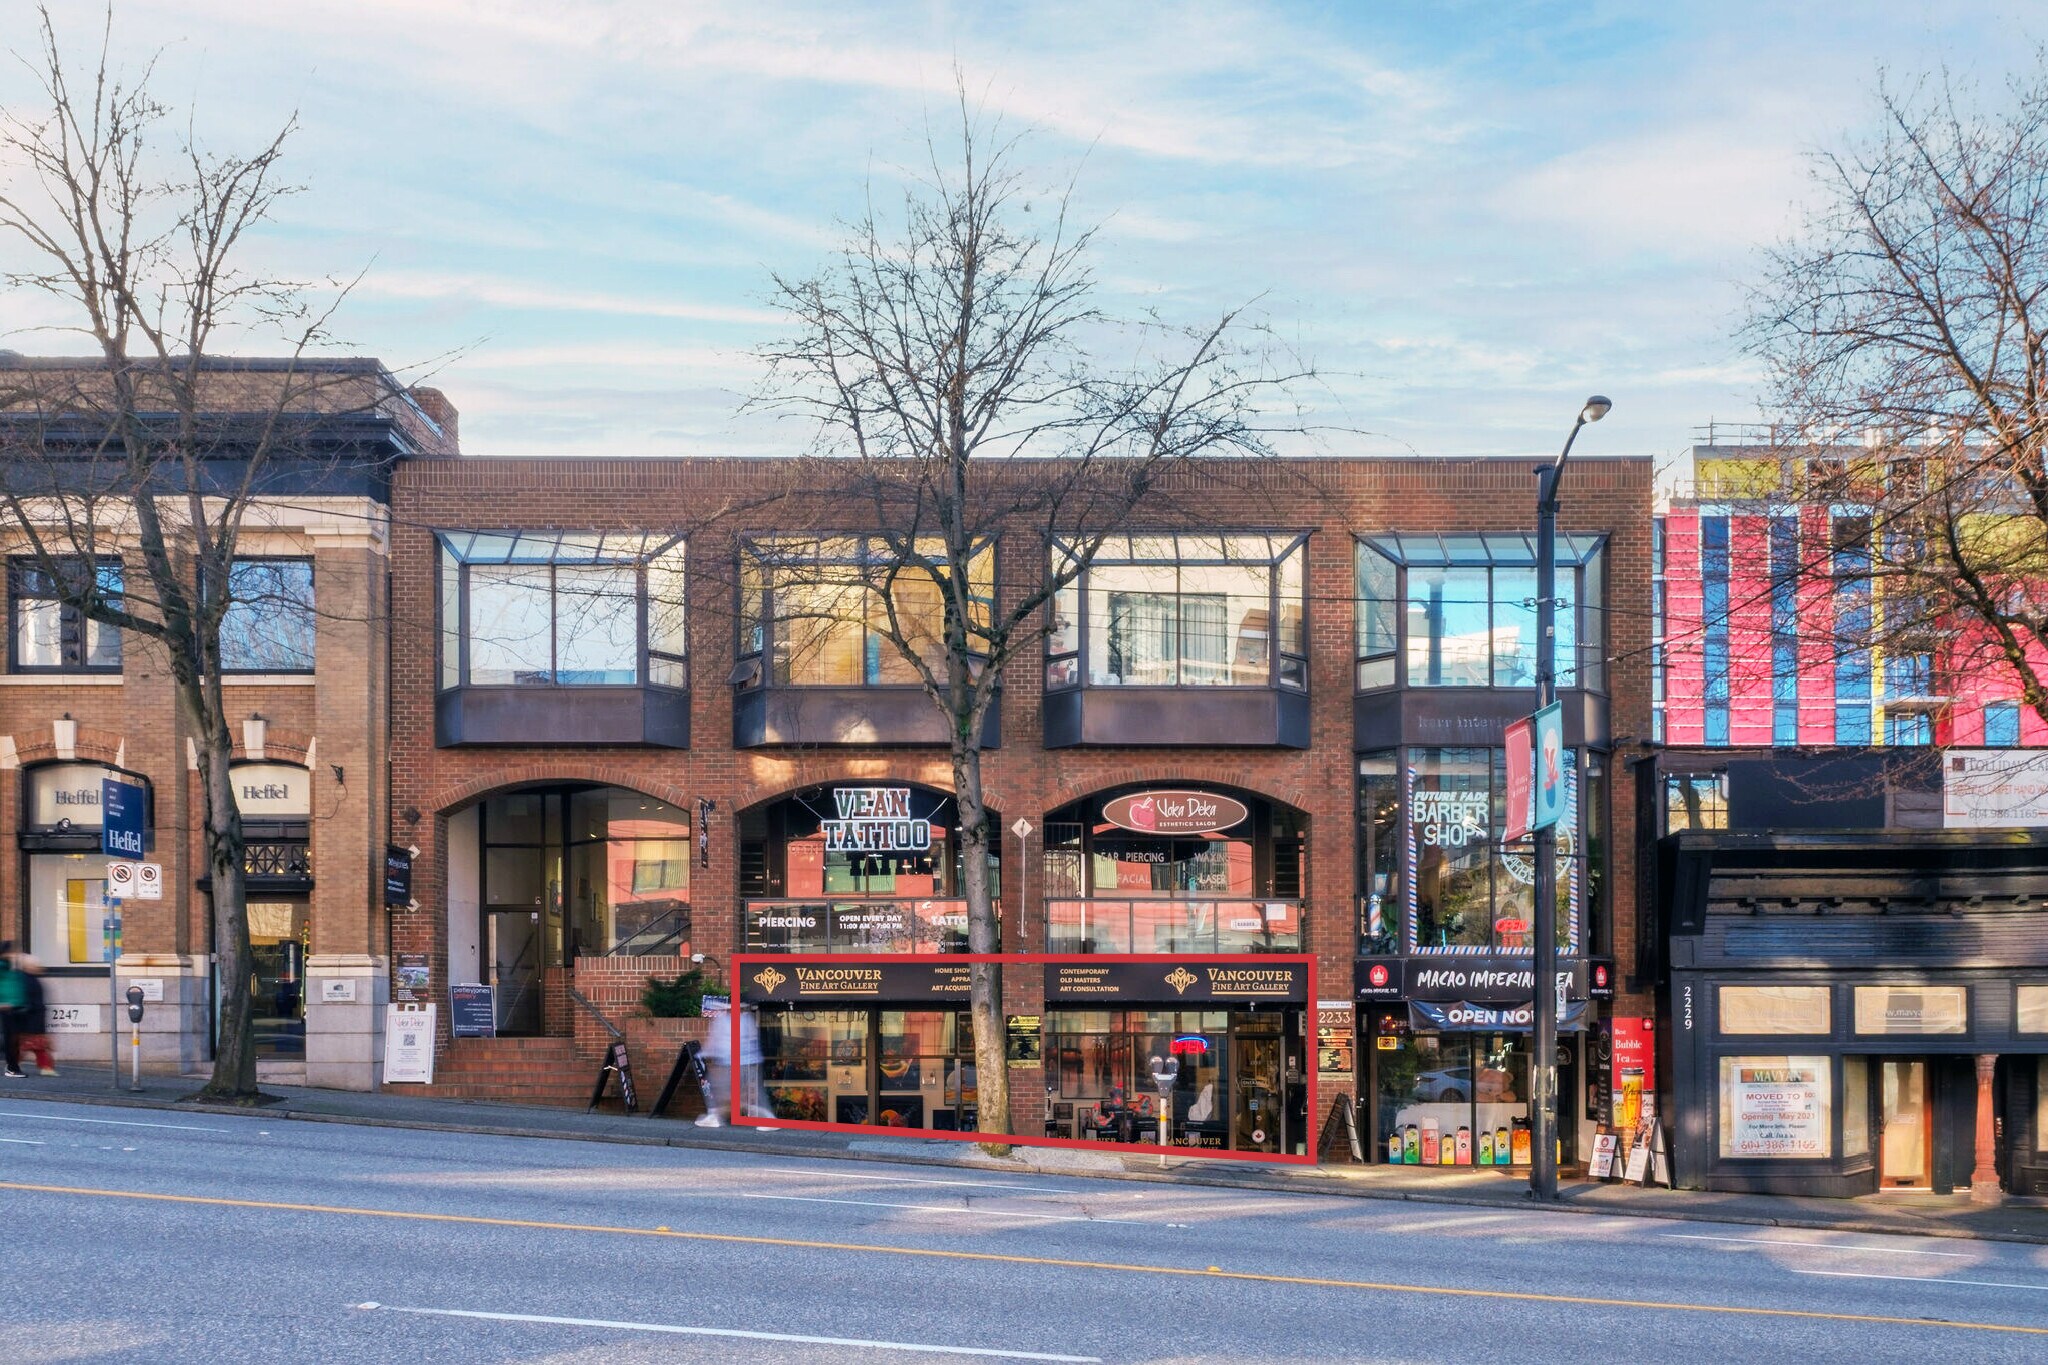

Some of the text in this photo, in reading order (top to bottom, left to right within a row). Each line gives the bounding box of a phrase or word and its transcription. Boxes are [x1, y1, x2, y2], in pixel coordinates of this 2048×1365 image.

[55, 789, 99, 805] Heffel
[243, 783, 288, 800] Heffel
[1413, 791, 1490, 802] FUTURE FADE
[833, 788, 911, 819] VEAN
[1413, 801, 1489, 824] BARBER
[820, 819, 930, 851] TATTOO
[1423, 823, 1476, 846] SHOP
[108, 829, 142, 854] Heffel
[1100, 852, 1165, 863] EAR PIERCING
[758, 917, 817, 928] PIERCING
[839, 915, 903, 923] OPEN EVERY DAY
[1495, 918, 1529, 933] OPEN
[859, 922, 871, 930] AM
[795, 967, 883, 981] VANCOUVER
[1206, 967, 1293, 981] VANCOUVER
[1417, 969, 1467, 988] MACAO
[799, 981, 879, 990] FINE ART GALLERY
[1211, 982, 1289, 991] FINE ART GALLERY
[1683, 985, 1693, 1030] 2229
[52, 1009, 79, 1020] 2247
[1318, 1011, 1351, 1024] 2233
[1448, 1010, 1500, 1024] OPEN
[1170, 1040, 1206, 1055] OPEN
[1615, 1039, 1643, 1049] Bubble
[1614, 1052, 1630, 1063] Tea
[1753, 1070, 1803, 1083] MAVYAN
[1746, 1093, 1801, 1101] MOVED TO
[1741, 1112, 1774, 1121] Opening
[1778, 1112, 1795, 1121] May
